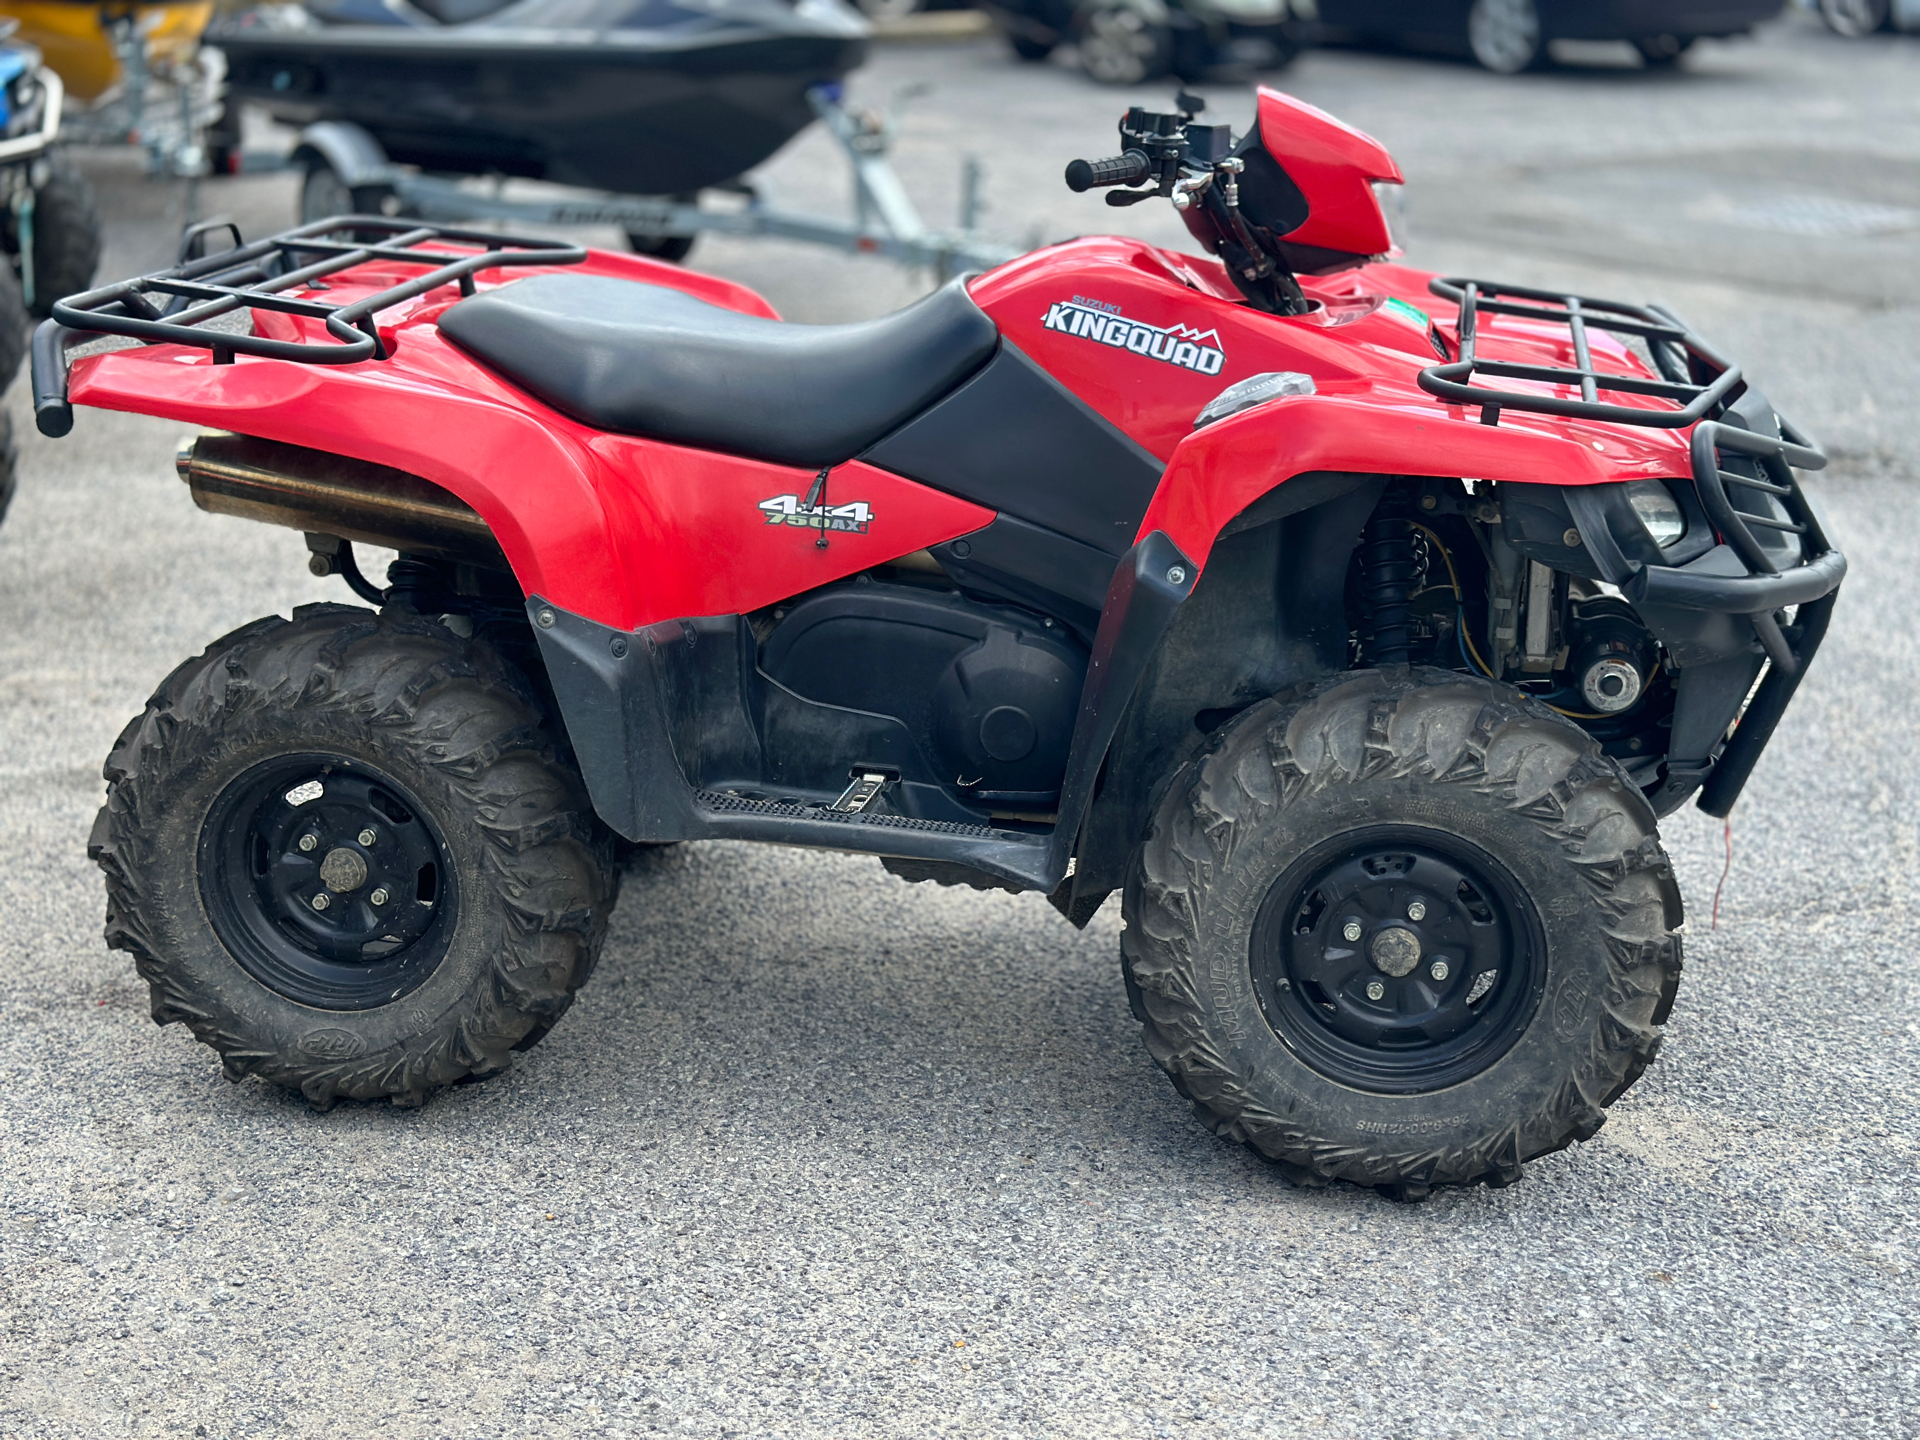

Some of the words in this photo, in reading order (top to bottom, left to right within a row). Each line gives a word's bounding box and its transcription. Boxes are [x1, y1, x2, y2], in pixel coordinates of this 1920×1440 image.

[1043, 303, 1225, 376] KINGQUAD
[1071, 295, 1122, 315] SUZUKI
[1209, 953, 1247, 1041] MUD
